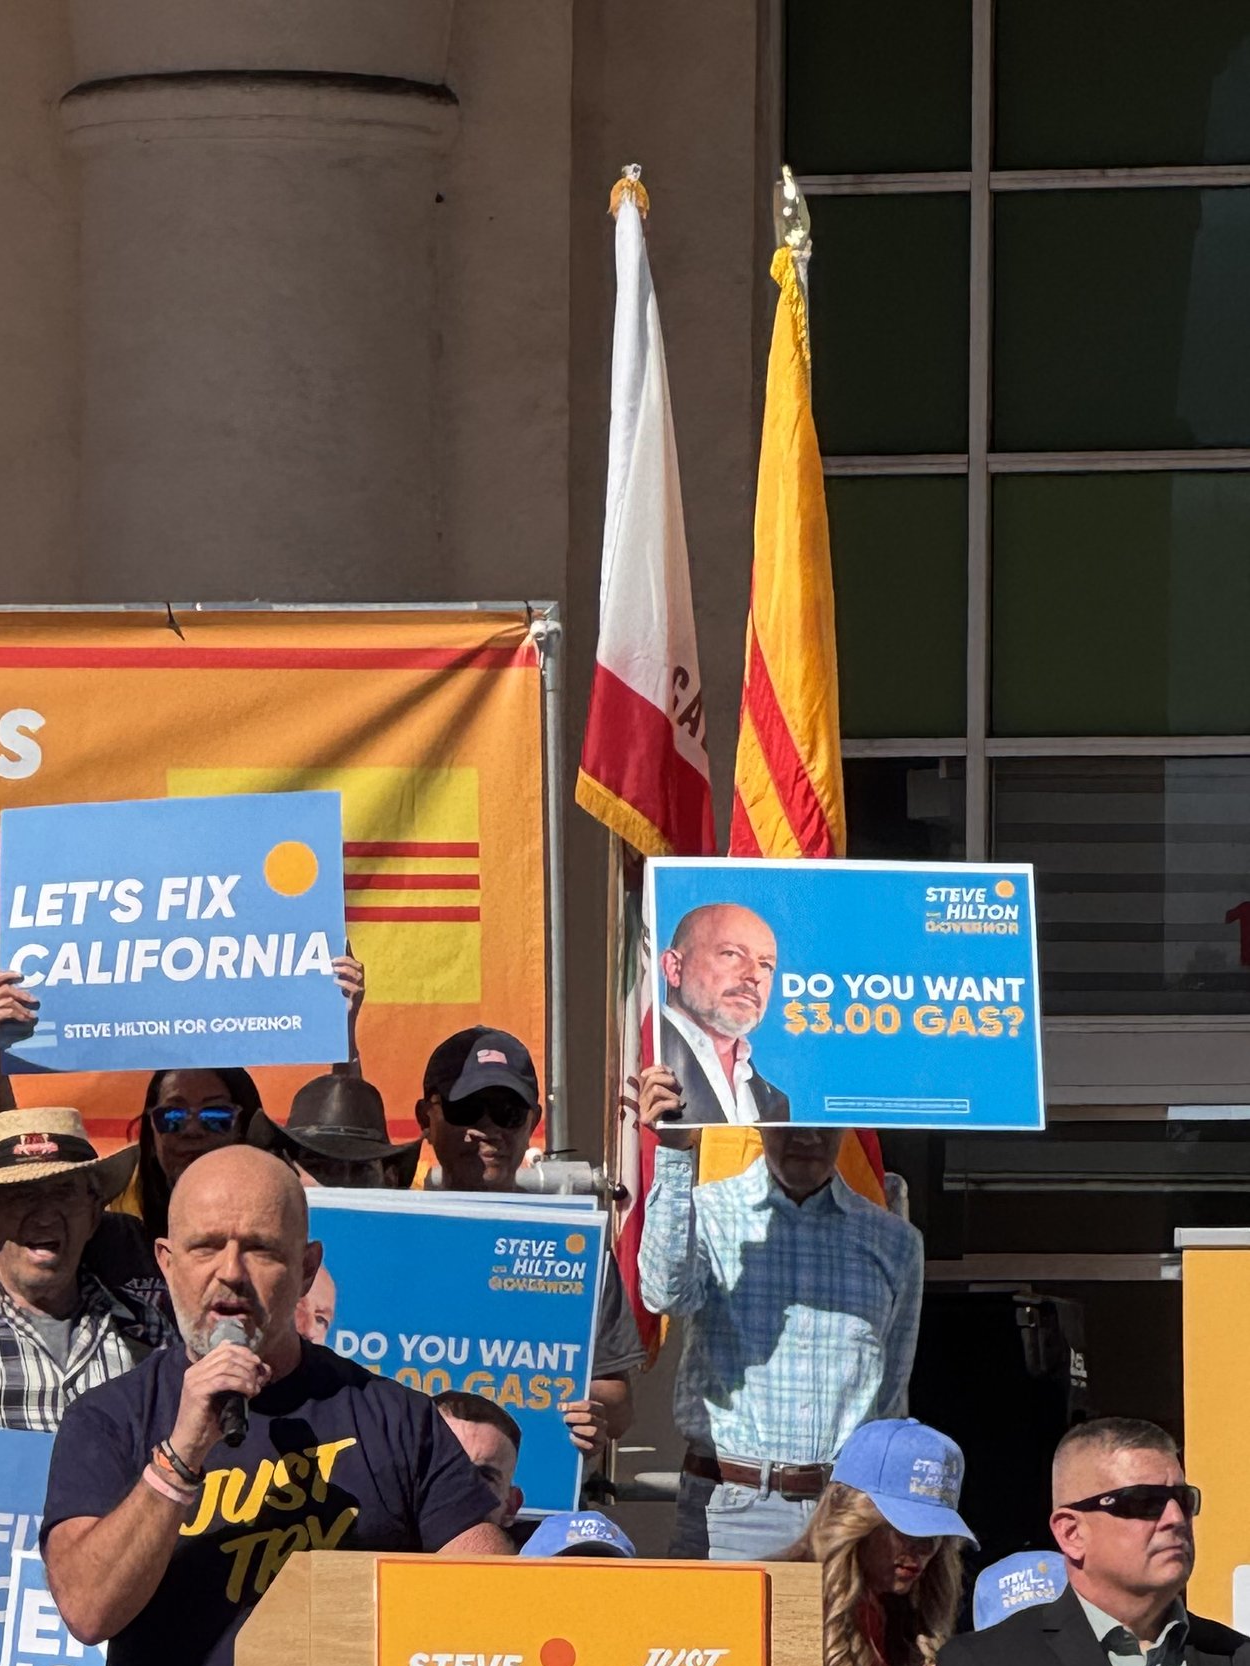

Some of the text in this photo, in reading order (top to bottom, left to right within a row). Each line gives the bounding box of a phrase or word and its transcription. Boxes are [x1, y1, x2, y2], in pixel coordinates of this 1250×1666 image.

[9, 878, 144, 929] LET'S
[157, 874, 241, 921] FIX
[926, 887, 987, 903] STEVE
[947, 905, 1019, 920] HILTON
[9, 931, 335, 989] CALIFORNIA
[782, 973, 1025, 1002] DO YOU WANT
[64, 1015, 302, 1039] STEVE HILTON FOR GOVERNOR
[783, 1000, 1025, 1037] $3.00 GAS?
[495, 1238, 557, 1258] STEVE
[513, 1259, 587, 1280] HILTON
[334, 1330, 581, 1372] DO YOU WANT
[179, 1437, 357, 1536] JUST
[220, 1507, 359, 1604] TRY
